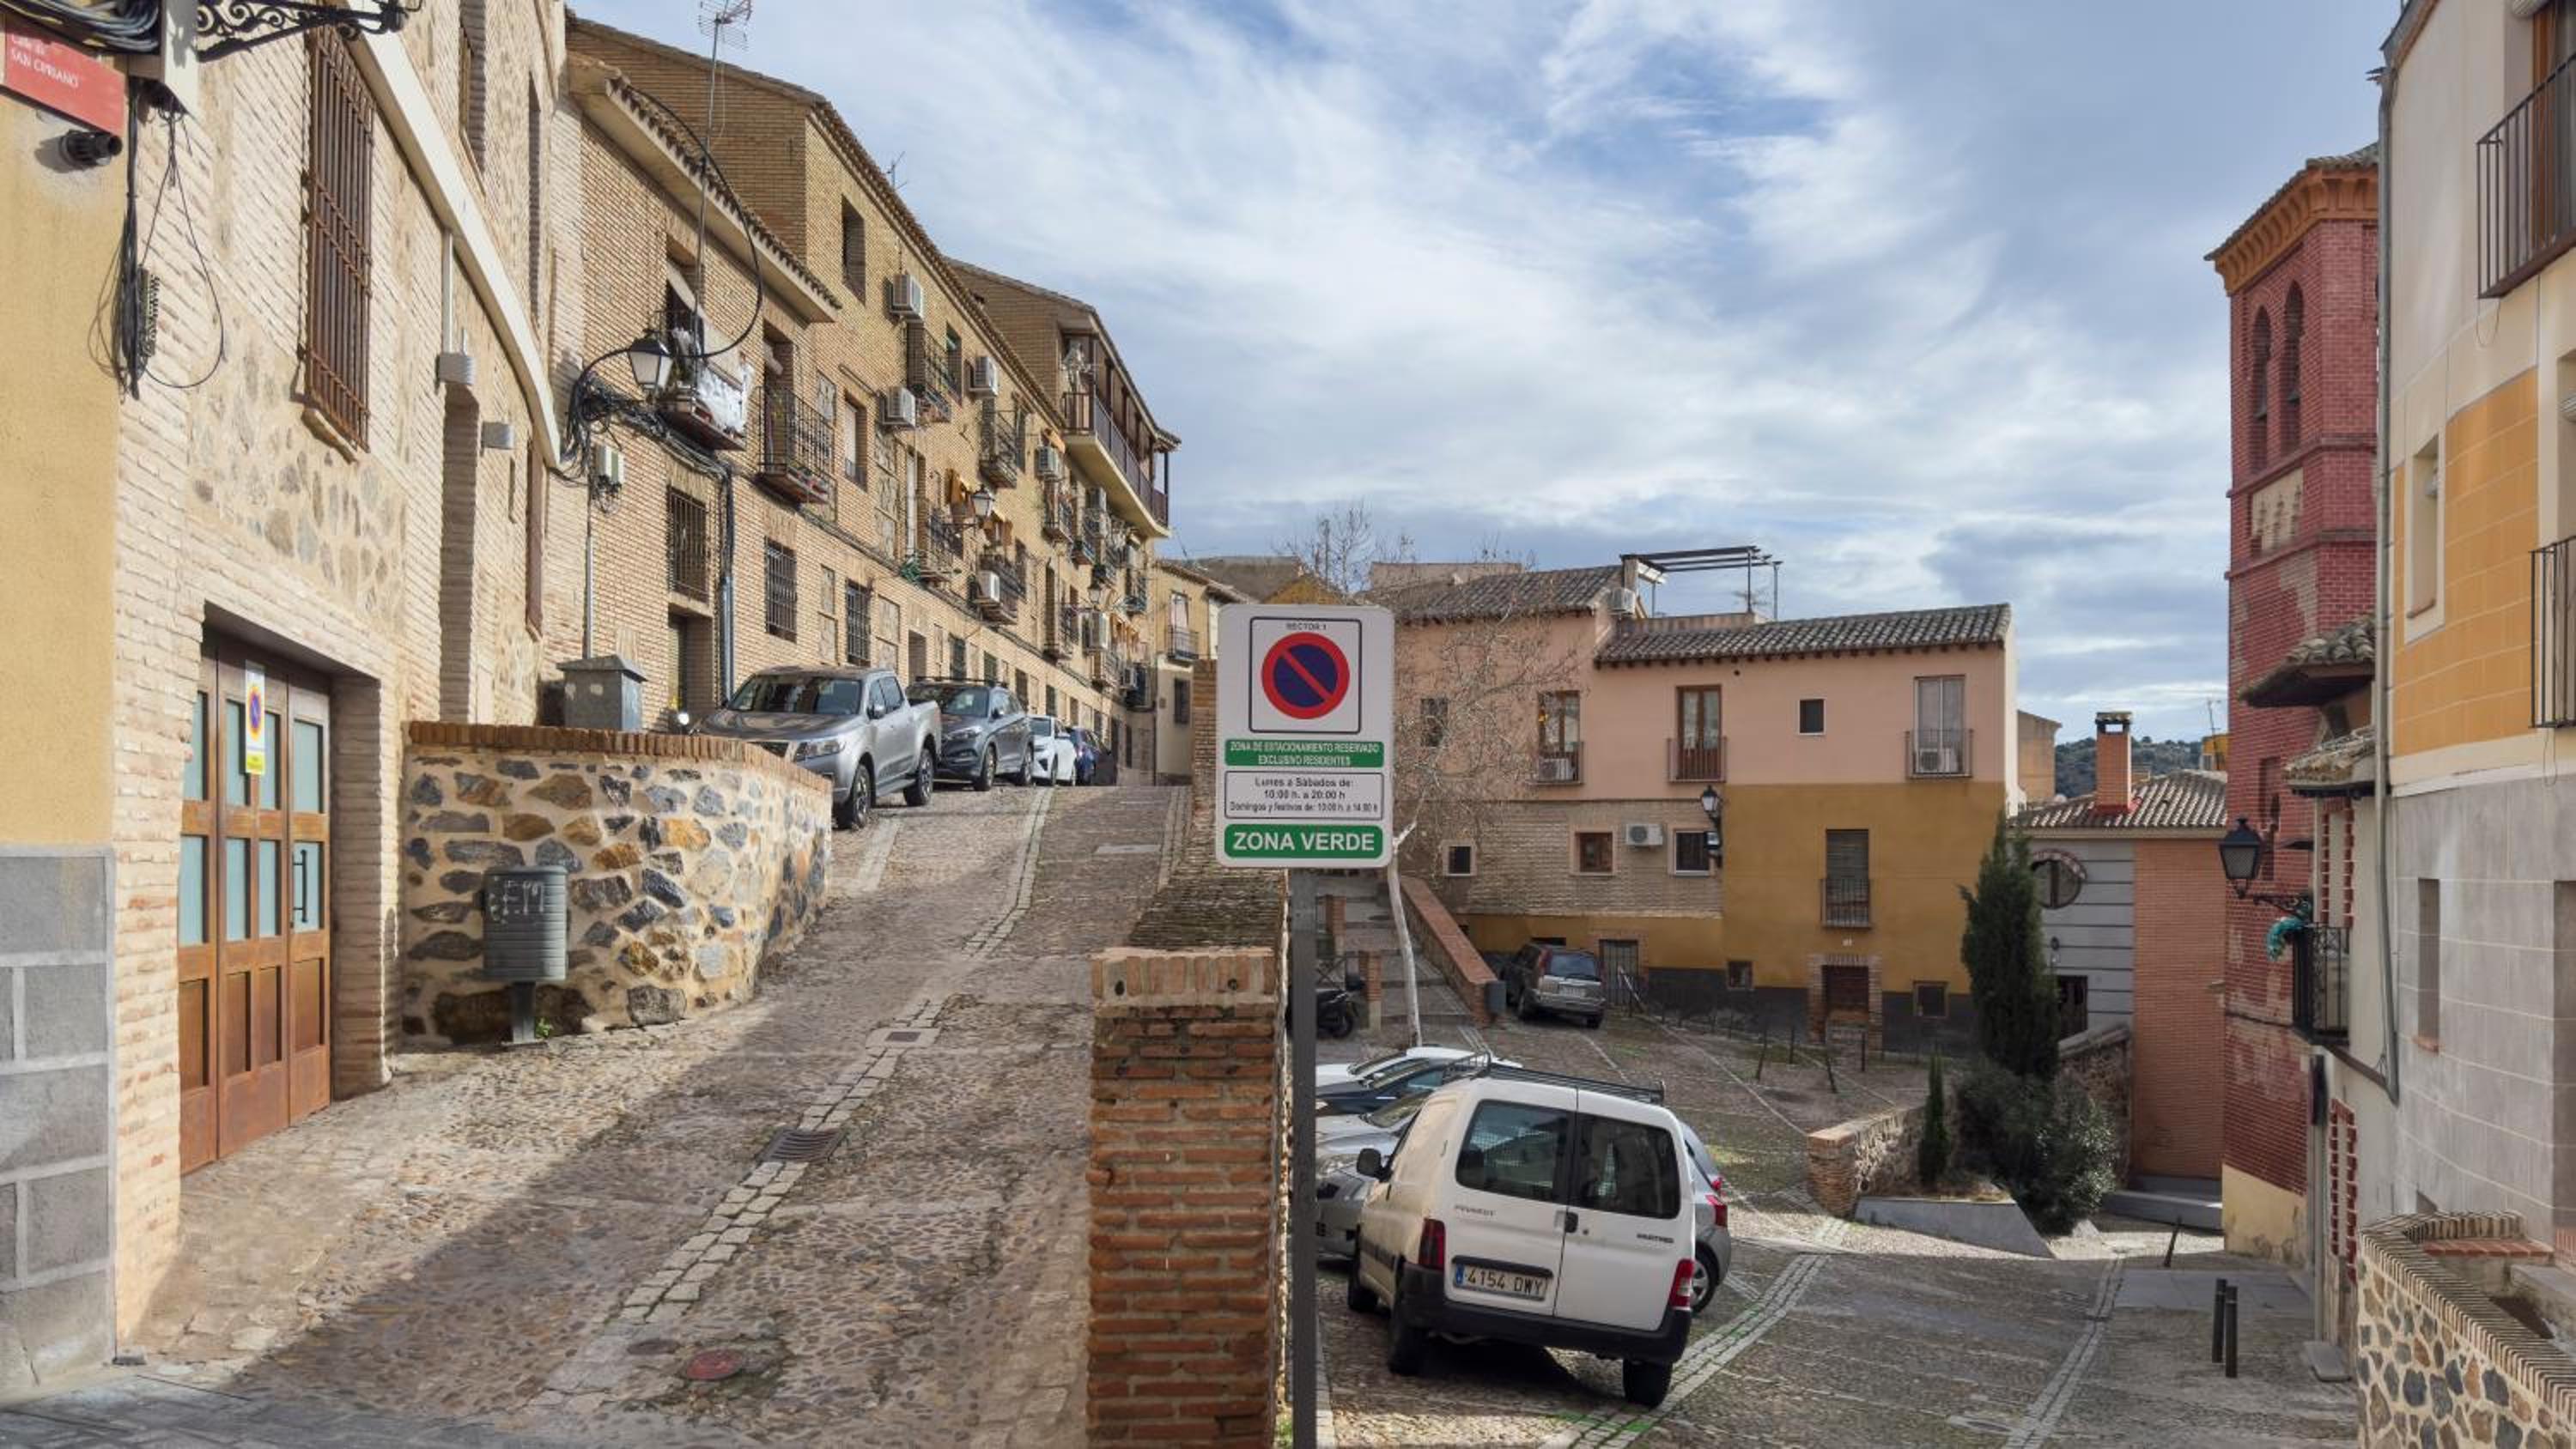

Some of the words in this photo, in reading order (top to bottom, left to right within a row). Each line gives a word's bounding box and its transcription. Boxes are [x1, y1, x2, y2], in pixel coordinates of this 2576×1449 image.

[11, 48, 32, 68] SAN
[33, 58, 80, 88] CIPRIANO
[1230, 741, 1251, 751] ZONA
[1253, 742, 1264, 751] DE
[1265, 742, 1334, 753] ESTACIONAMIENTO
[1334, 743, 1380, 754] RESERVADO
[1258, 755, 1303, 765] EXCLUSIVO
[1303, 755, 1351, 766] RESIDENTES
[1255, 778, 1285, 787] Lunes
[1286, 779, 1293, 787] a
[1265, 789, 1289, 799] 10:00
[1311, 790, 1337, 800] 20:00
[1230, 801, 1267, 814] Domingos
[1273, 802, 1303, 811] festivos
[1232, 832, 1296, 851] ZONA
[1299, 833, 1376, 852] VERDE
[1467, 1268, 1506, 1290] 4154
[1513, 1276, 1543, 1295] DWY
